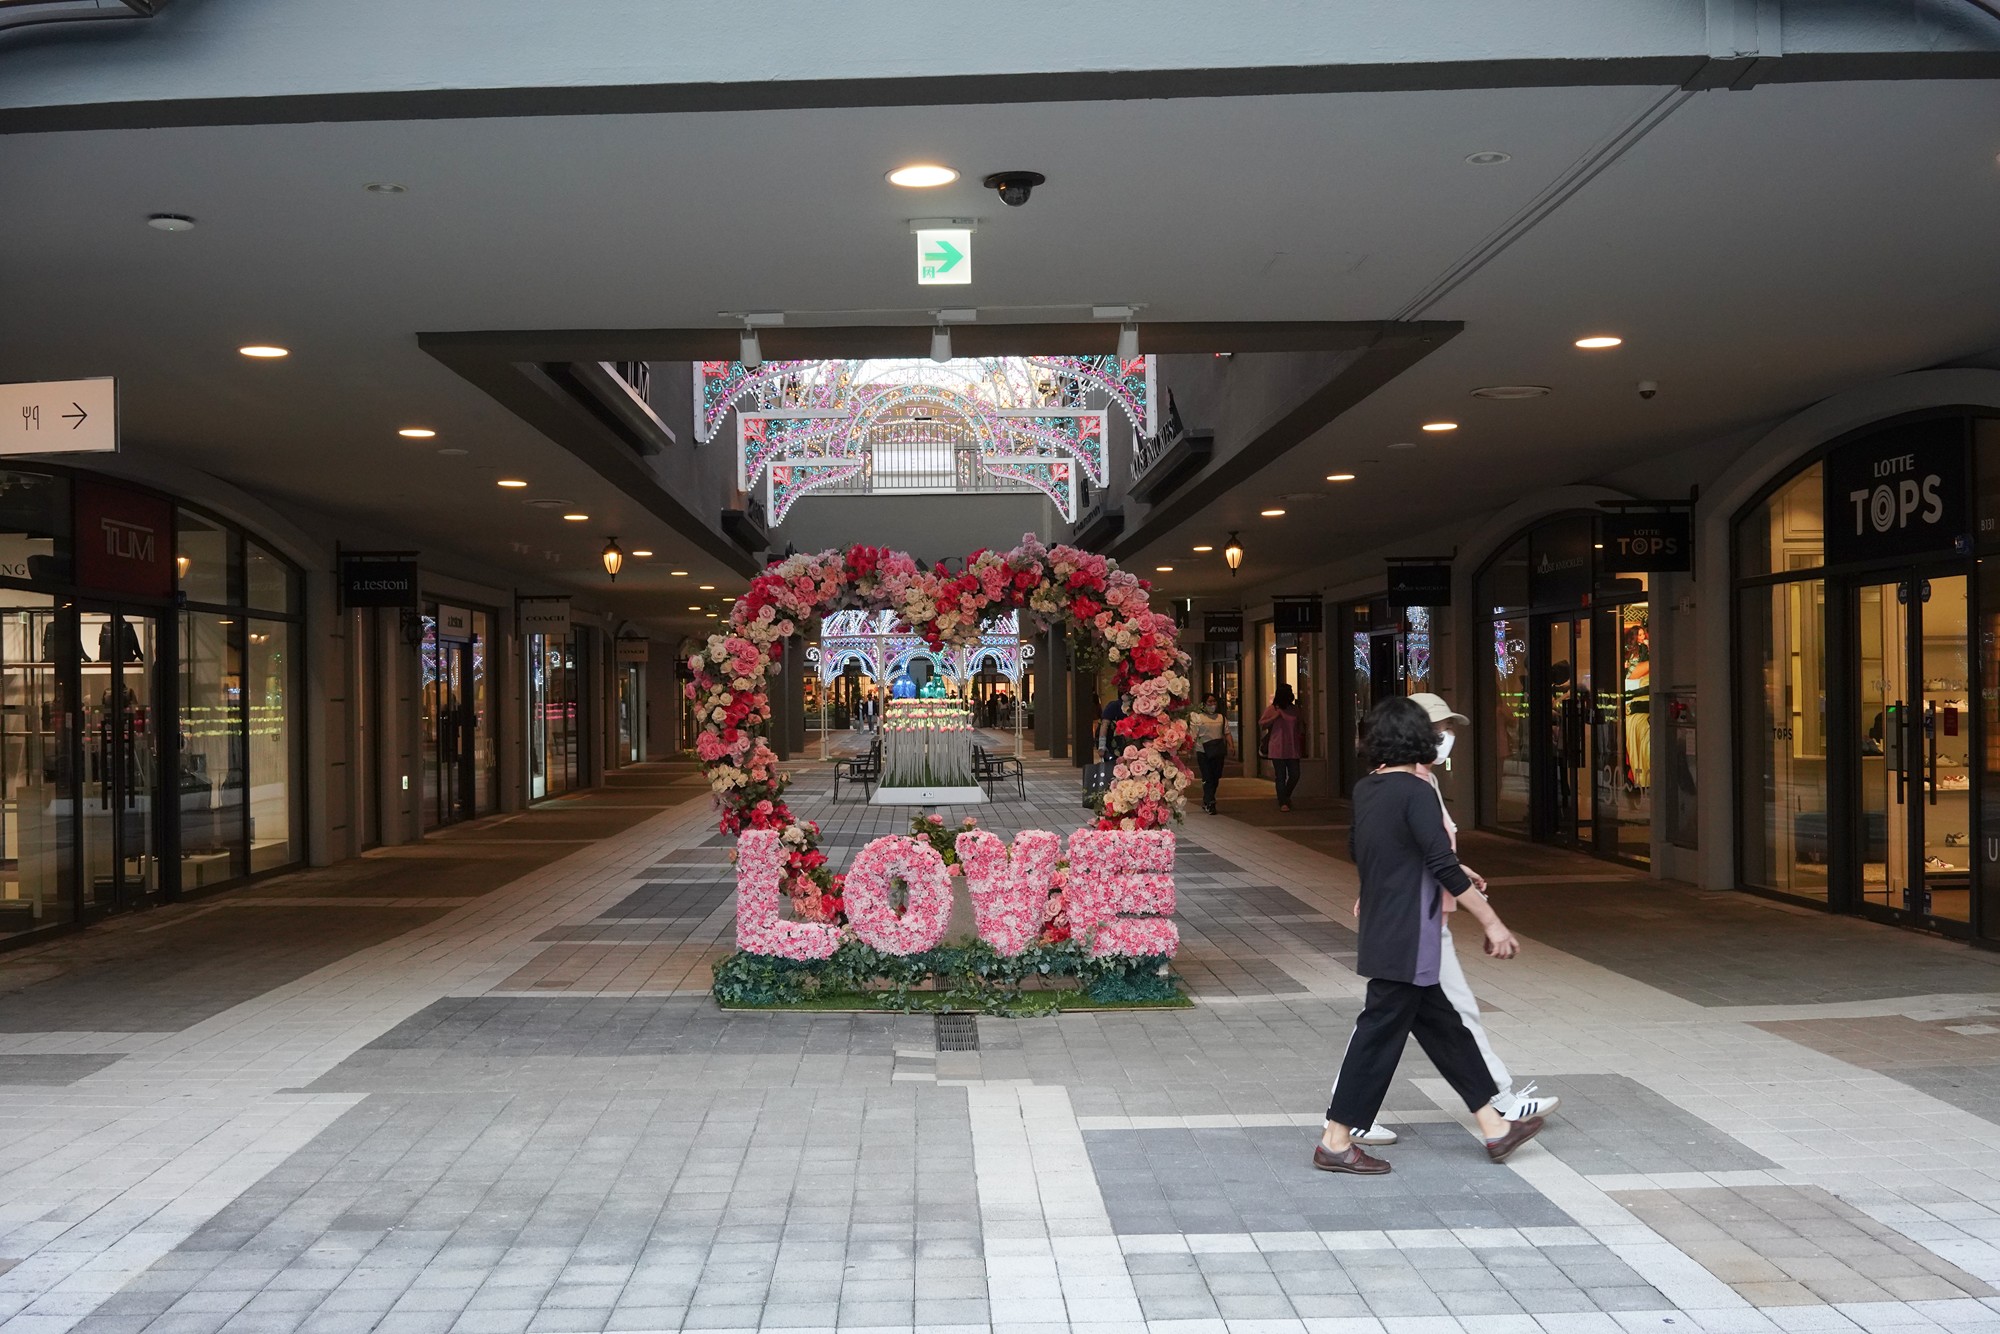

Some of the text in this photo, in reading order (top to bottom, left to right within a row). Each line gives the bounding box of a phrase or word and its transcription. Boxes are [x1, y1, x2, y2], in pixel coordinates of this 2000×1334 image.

[1874, 453, 1915, 478] LOTTE
[1849, 473, 1943, 537] TOPS
[101, 517, 155, 562] TUMI
[1616, 537, 1679, 556] TOPS
[352, 578, 409, 591] a.testoni
[1773, 727, 1793, 741] TOPS
[736, 826, 1180, 962] LOVE
